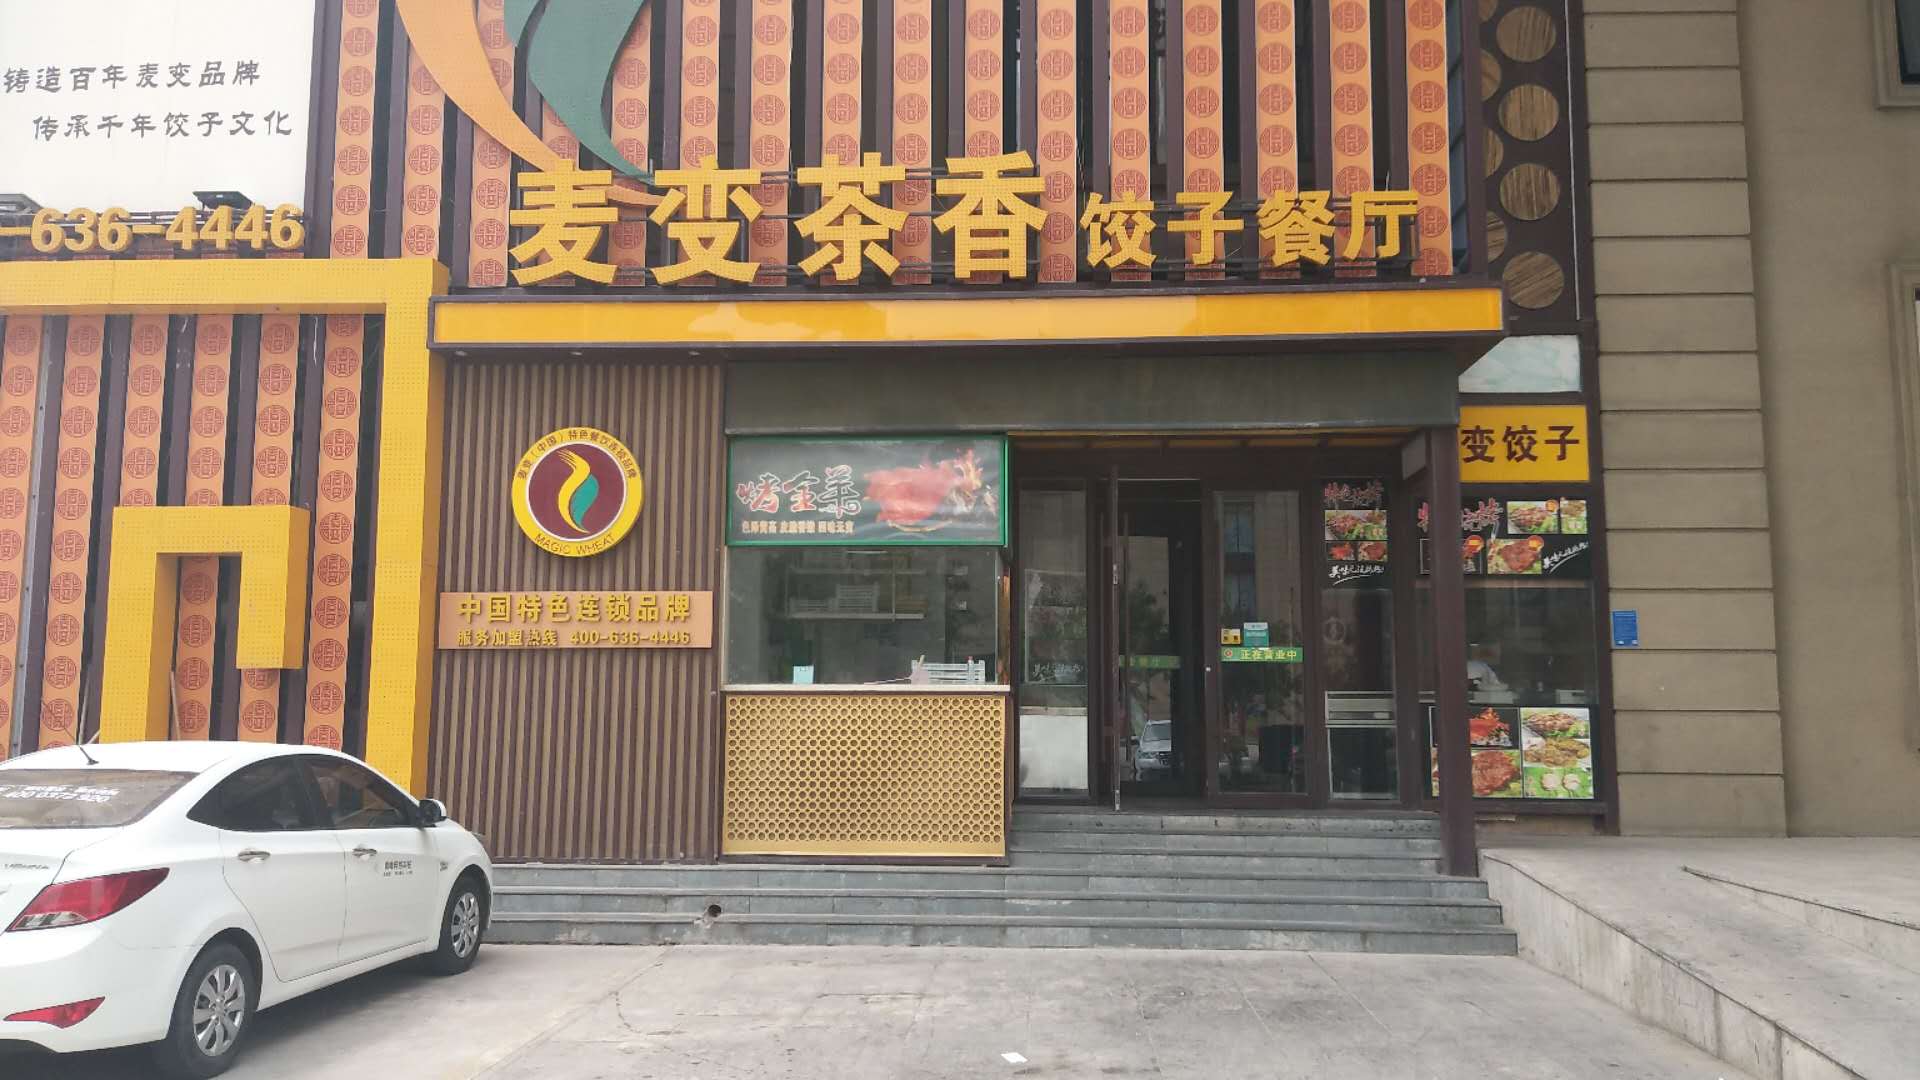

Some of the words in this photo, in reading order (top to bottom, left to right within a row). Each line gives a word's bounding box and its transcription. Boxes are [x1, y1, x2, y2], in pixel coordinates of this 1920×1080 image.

[3, 59, 261, 94] 铸造百年麦变品牌
[32, 109, 293, 142] 传承千年饺子文化
[533, 533, 572, 555] MAGIC
[575, 533, 616, 555] WHEAT
[457, 593, 691, 624] 中国特色连锁品牌
[457, 629, 559, 648] 服务加盟热线
[569, 630, 691, 646] 400-636-4446
[1240, 648, 1297, 661] 正在营业中
